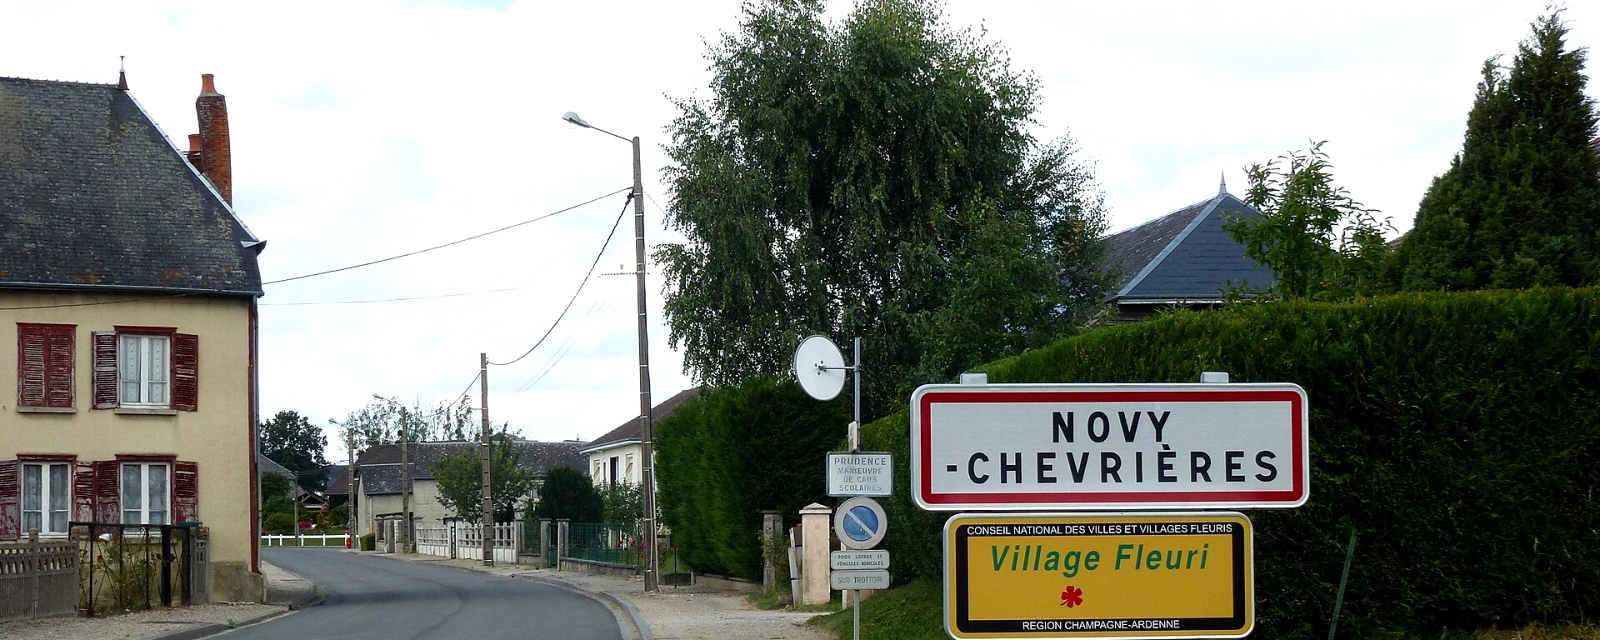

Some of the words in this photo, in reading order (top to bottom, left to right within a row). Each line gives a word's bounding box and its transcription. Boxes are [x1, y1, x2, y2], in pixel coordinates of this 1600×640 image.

[1052, 411, 1172, 443] NOVY
[946, 444, 1277, 484] -CHEVRIÈRES
[967, 526, 1011, 535] CONSEIL
[1013, 526, 1063, 535] NATIONAL
[1065, 525, 1086, 534] DES
[1087, 525, 1122, 534] VILLES
[1124, 524, 1137, 534] ET
[1139, 524, 1189, 534] VILLAGES
[1191, 524, 1233, 533] FLEURIS
[991, 545, 1101, 578] Village
[1115, 544, 1210, 570] Fleuri
[1022, 621, 1063, 630] REGION
[1064, 620, 1180, 630] CHAMPAGNE-ARDENNE
